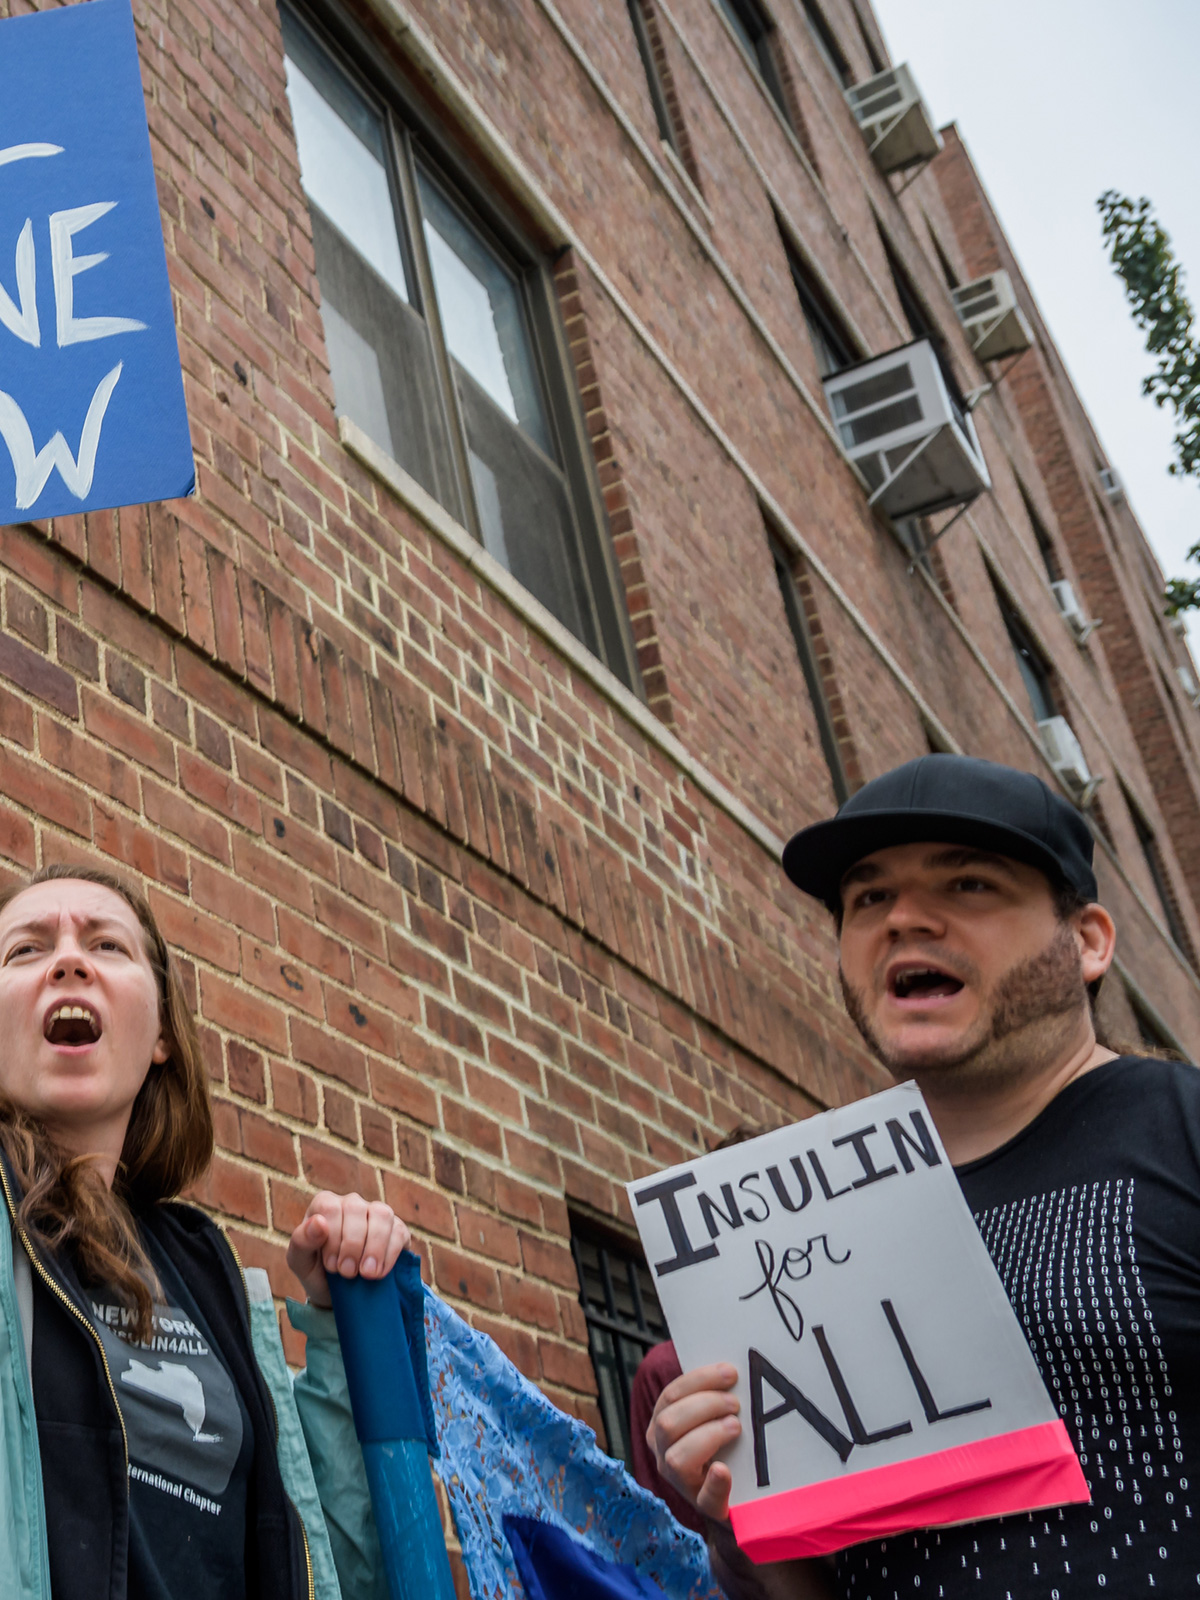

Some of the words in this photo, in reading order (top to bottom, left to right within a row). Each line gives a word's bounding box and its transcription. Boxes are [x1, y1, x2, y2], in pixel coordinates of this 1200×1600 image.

[91, 1301, 140, 1327] NEW
[738, 1233, 852, 1342] for
[748, 1298, 993, 1488] ALL
[183, 1487, 222, 1517] Chapter
